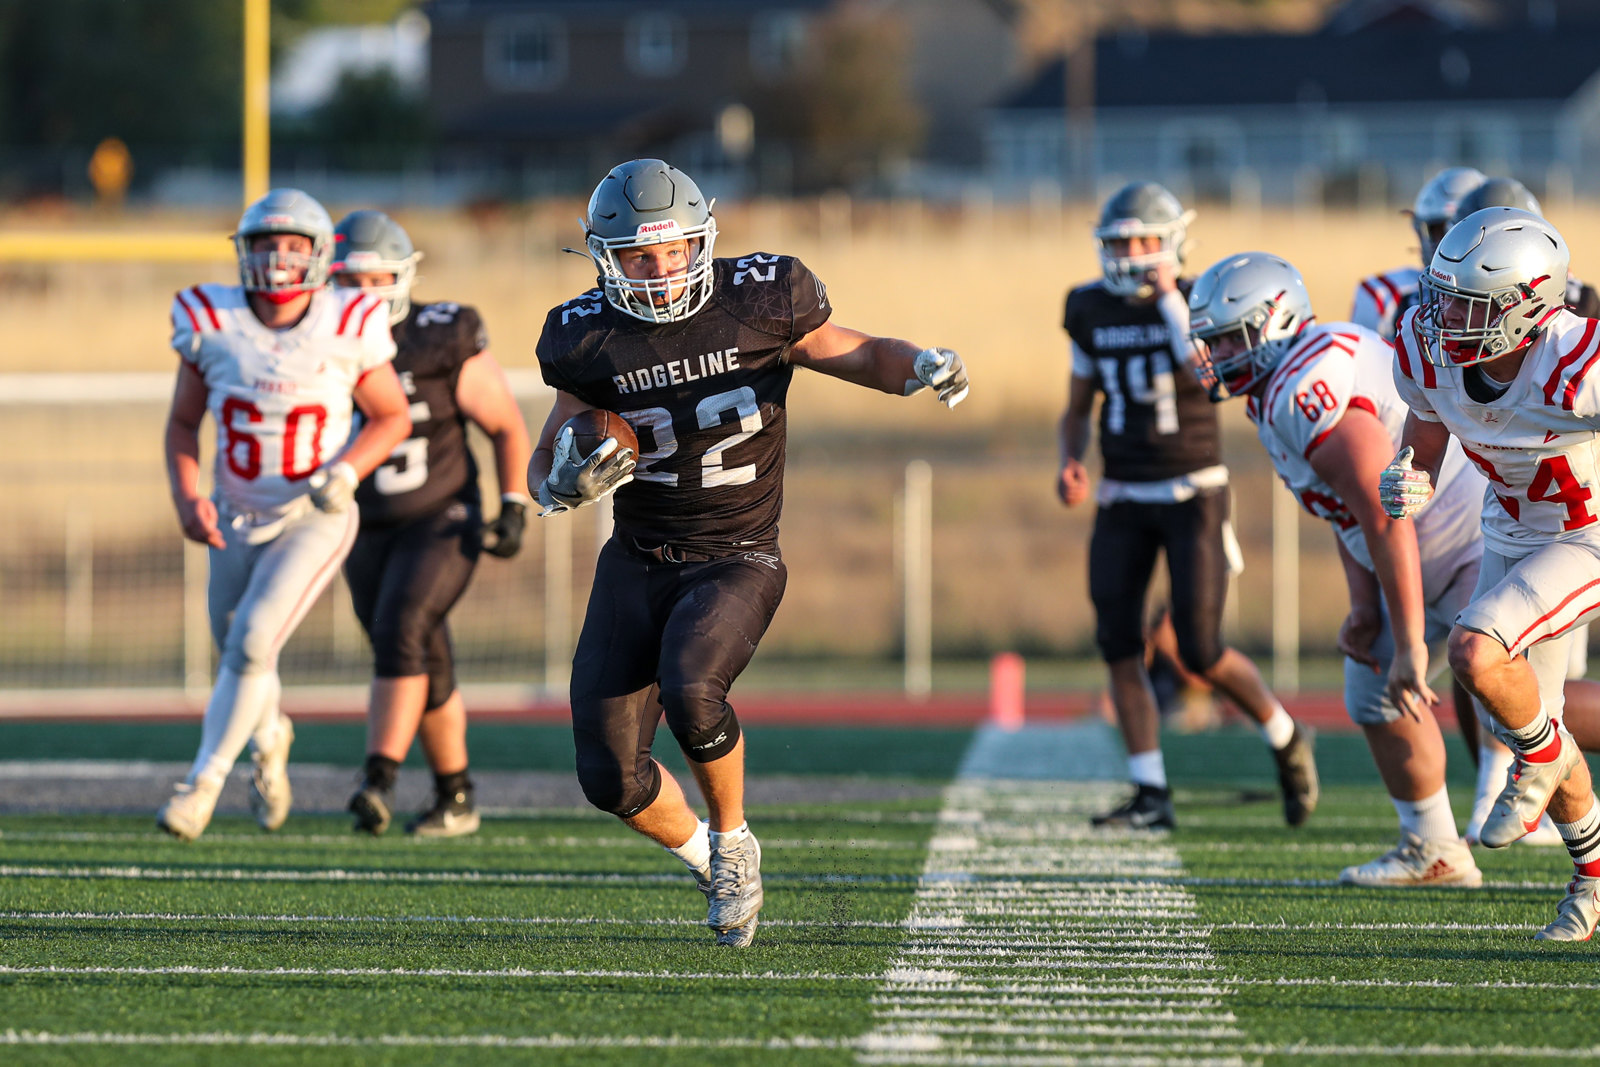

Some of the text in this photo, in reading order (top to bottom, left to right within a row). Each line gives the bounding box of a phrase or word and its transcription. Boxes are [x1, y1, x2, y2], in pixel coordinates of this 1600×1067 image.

[639, 221, 674, 234] Riddell
[733, 253, 780, 286] 22
[1431, 268, 1452, 282] Riddell
[611, 346, 741, 395] RIDGELINE
[1098, 350, 1180, 435] 14
[1296, 379, 1338, 422] 68
[222, 396, 327, 482] 60
[620, 386, 763, 488] 22
